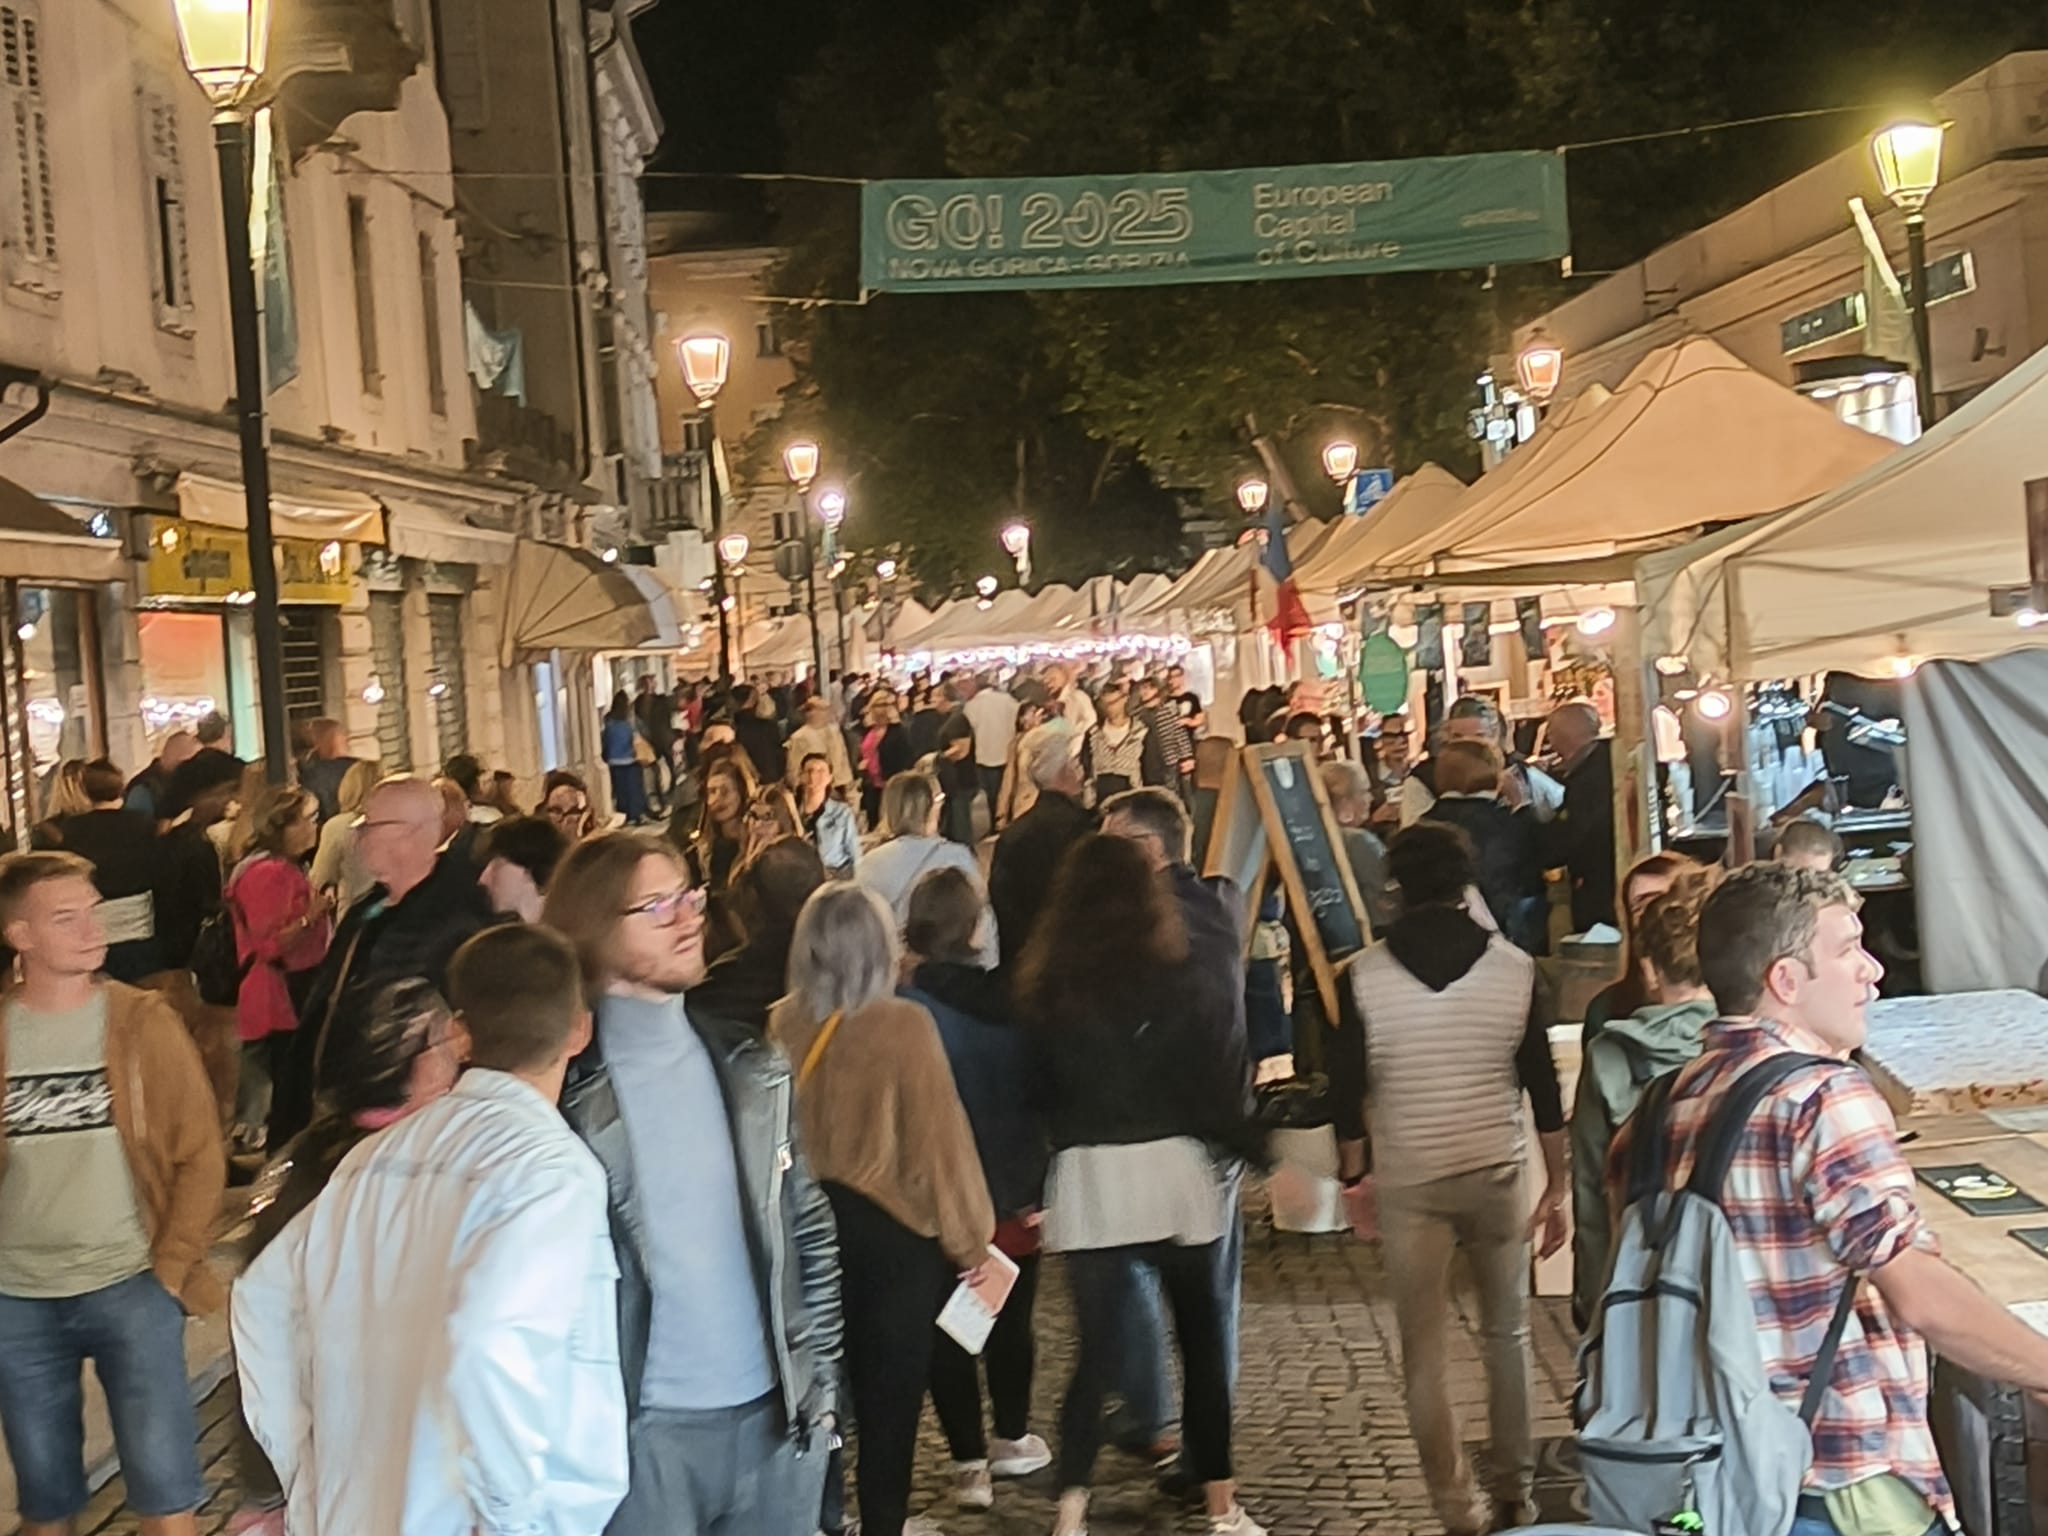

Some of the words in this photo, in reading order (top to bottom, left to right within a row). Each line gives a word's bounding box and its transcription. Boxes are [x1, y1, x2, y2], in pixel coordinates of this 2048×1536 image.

[1254, 182, 1393, 209] European
[887, 193, 1004, 250] GO!
[1020, 187, 1193, 249] 2025
[1255, 208, 1356, 240] Capital
[1257, 242, 1286, 265] of
[1295, 240, 1401, 263] Culture
[889, 257, 963, 279] NOVA
